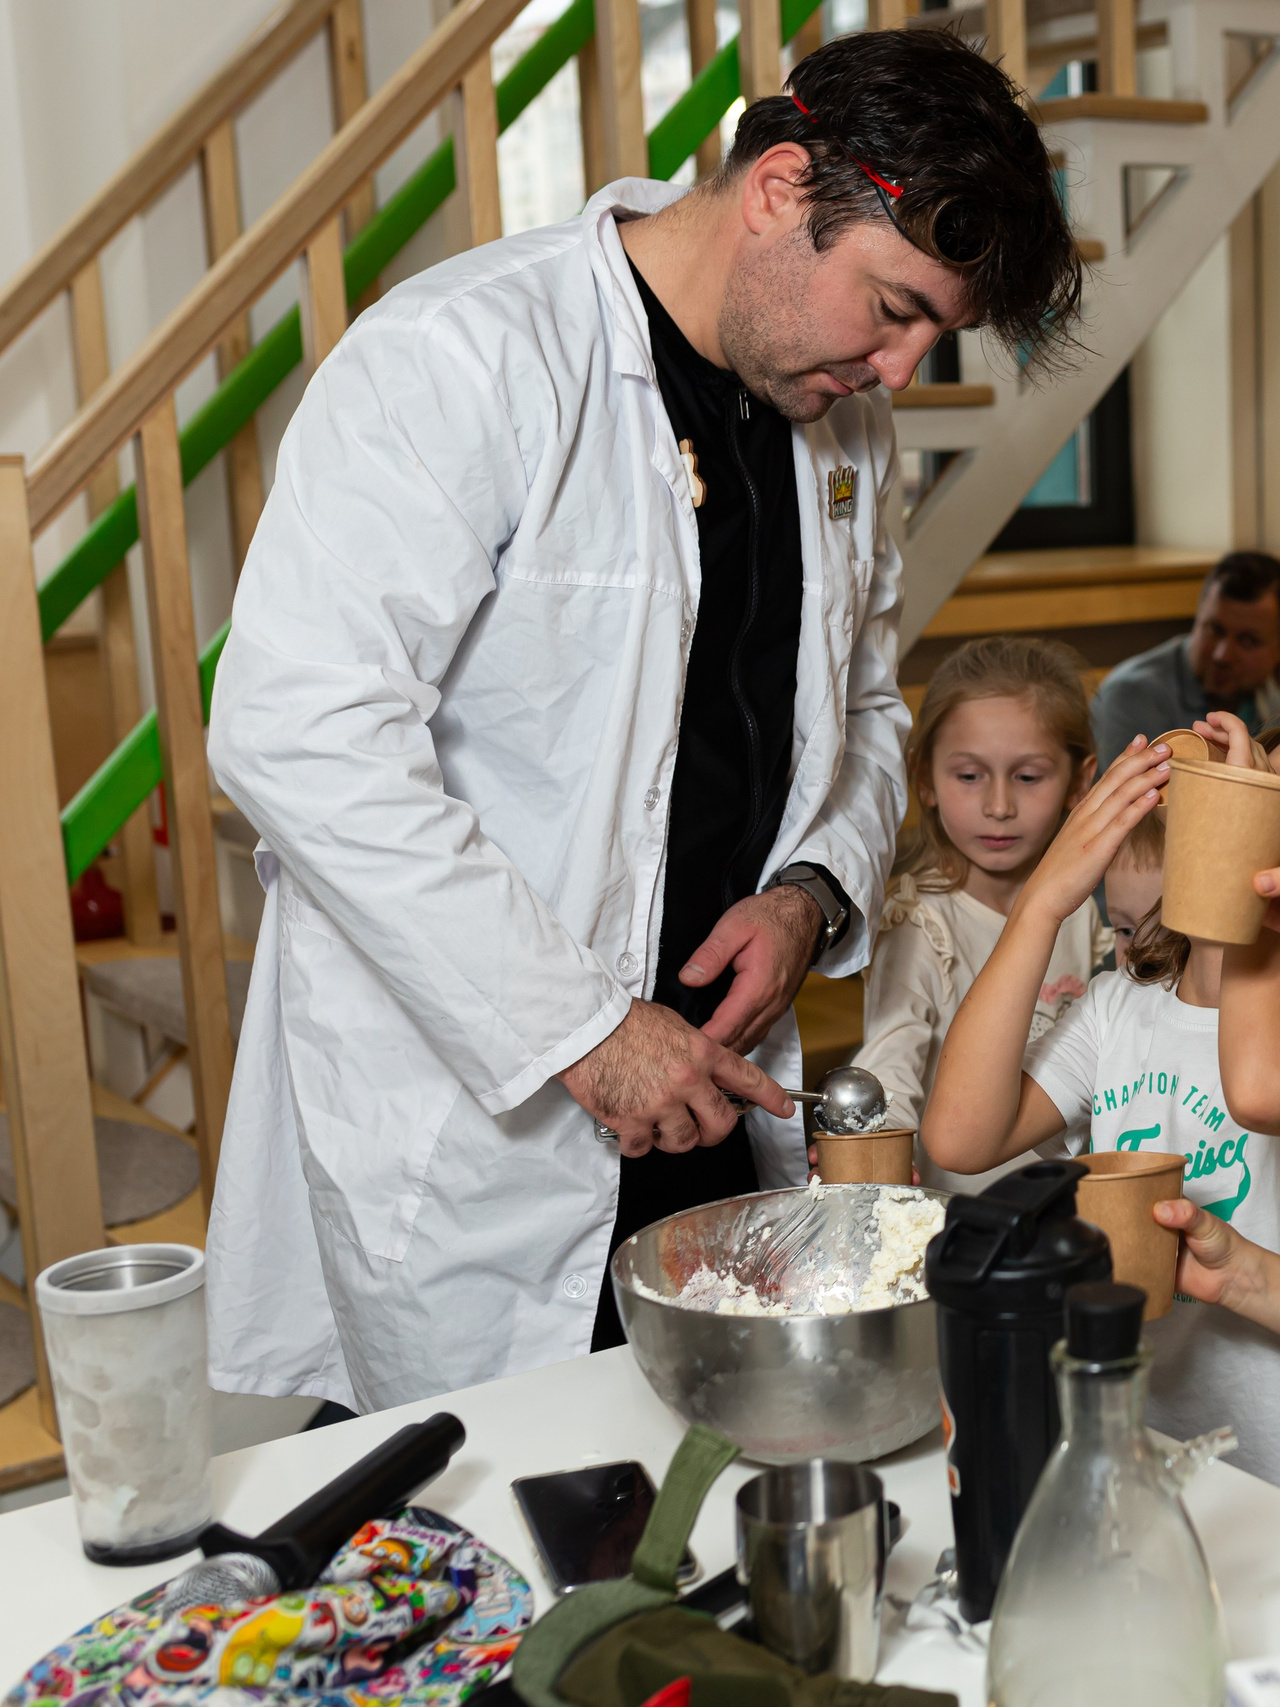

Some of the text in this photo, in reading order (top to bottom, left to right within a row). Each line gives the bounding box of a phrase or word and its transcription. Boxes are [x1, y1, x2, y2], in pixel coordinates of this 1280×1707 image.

[833, 499, 853, 518] KING
[1093, 1071, 1226, 1132] CHAMPION TEAM
